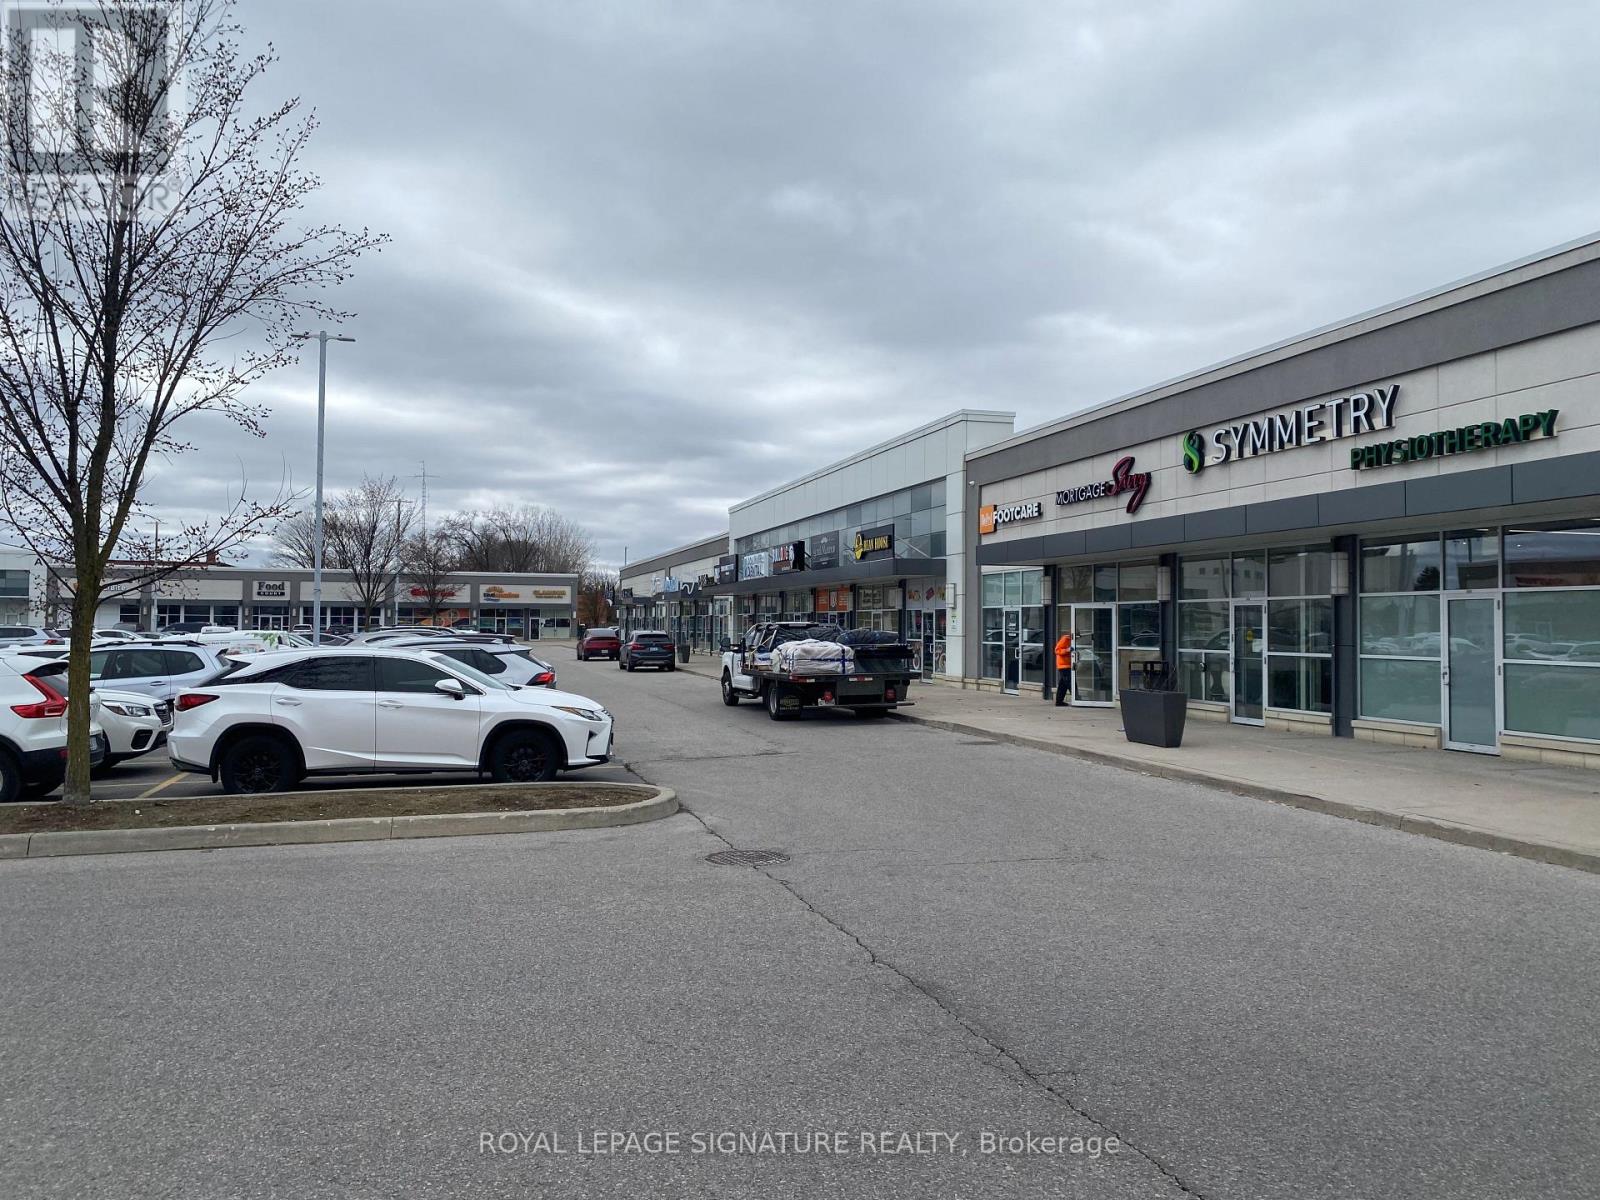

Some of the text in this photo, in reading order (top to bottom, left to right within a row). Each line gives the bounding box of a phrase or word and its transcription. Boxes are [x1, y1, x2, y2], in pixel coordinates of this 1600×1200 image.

[1211, 384, 1400, 464] SYMMETRY
[1350, 409, 1560, 470] PHYSIOTHERAPY
[1055, 482, 1106, 506] MORTGAGE
[992, 502, 1041, 525] FOOTCARE
[257, 581, 285, 591] Food
